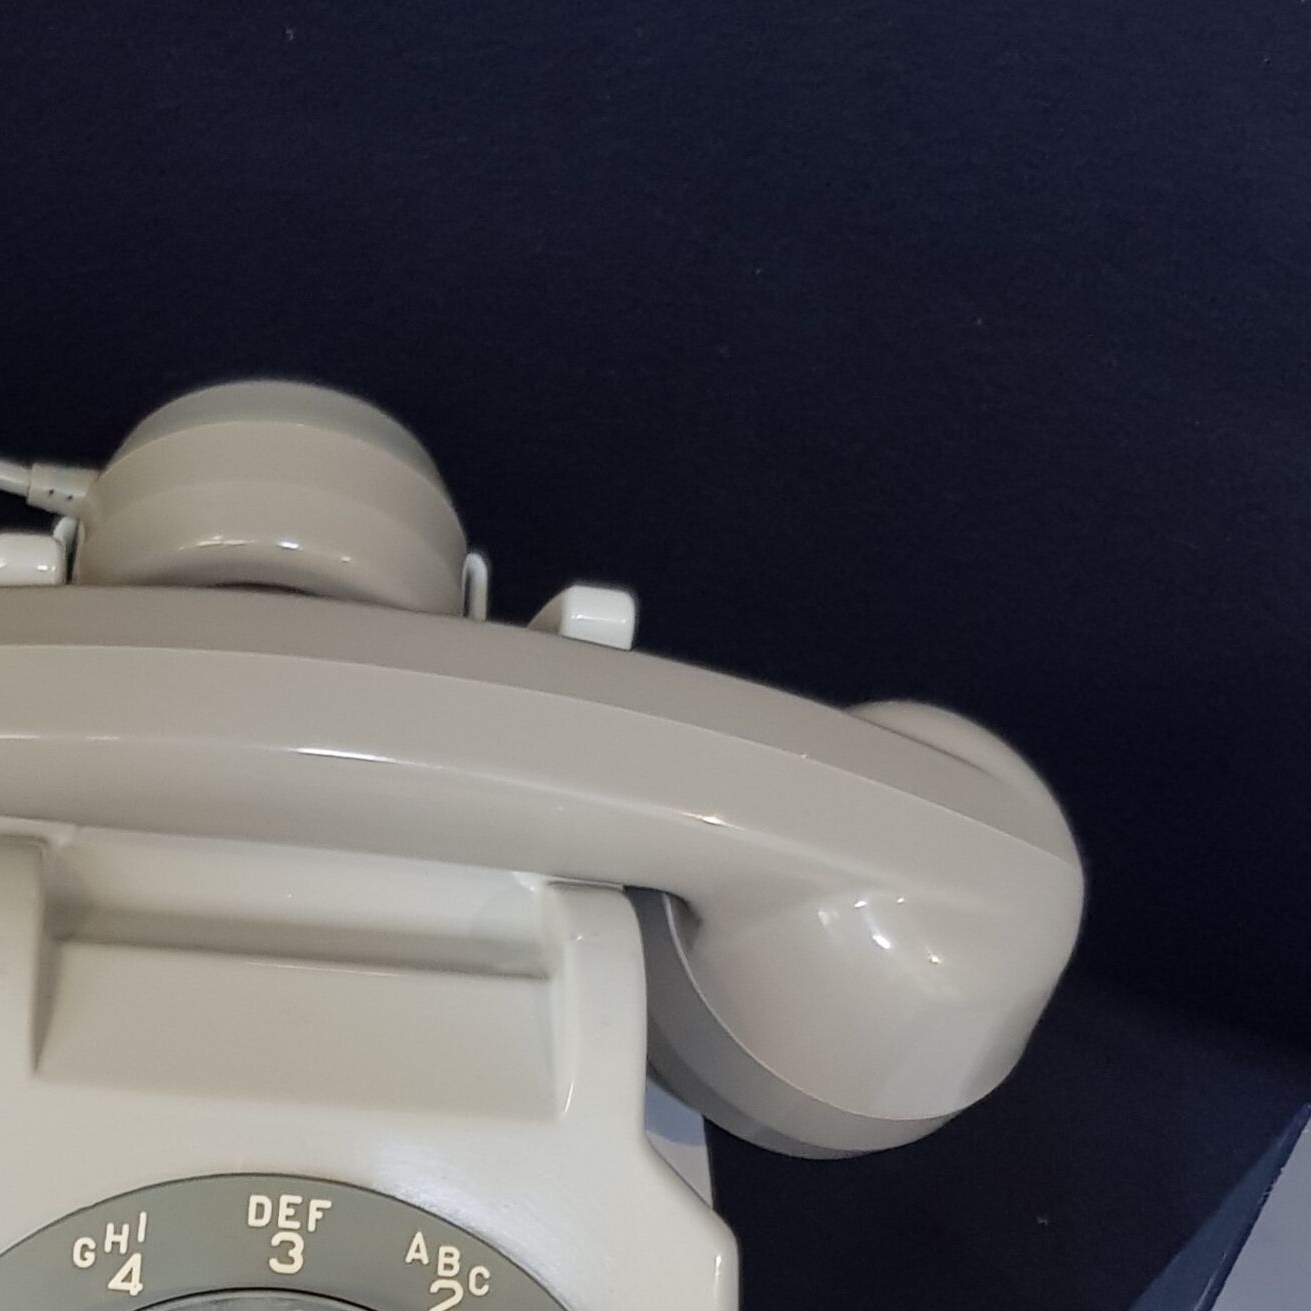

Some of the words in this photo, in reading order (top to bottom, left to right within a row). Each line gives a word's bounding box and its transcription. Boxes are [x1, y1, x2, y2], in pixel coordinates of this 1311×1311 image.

[247, 1194, 332, 1233] DEF
[73, 1211, 147, 1268] GHI
[268, 1231, 304, 1275] 3
[107, 1252, 144, 1297] 4
[405, 1230, 491, 1297] ABC
